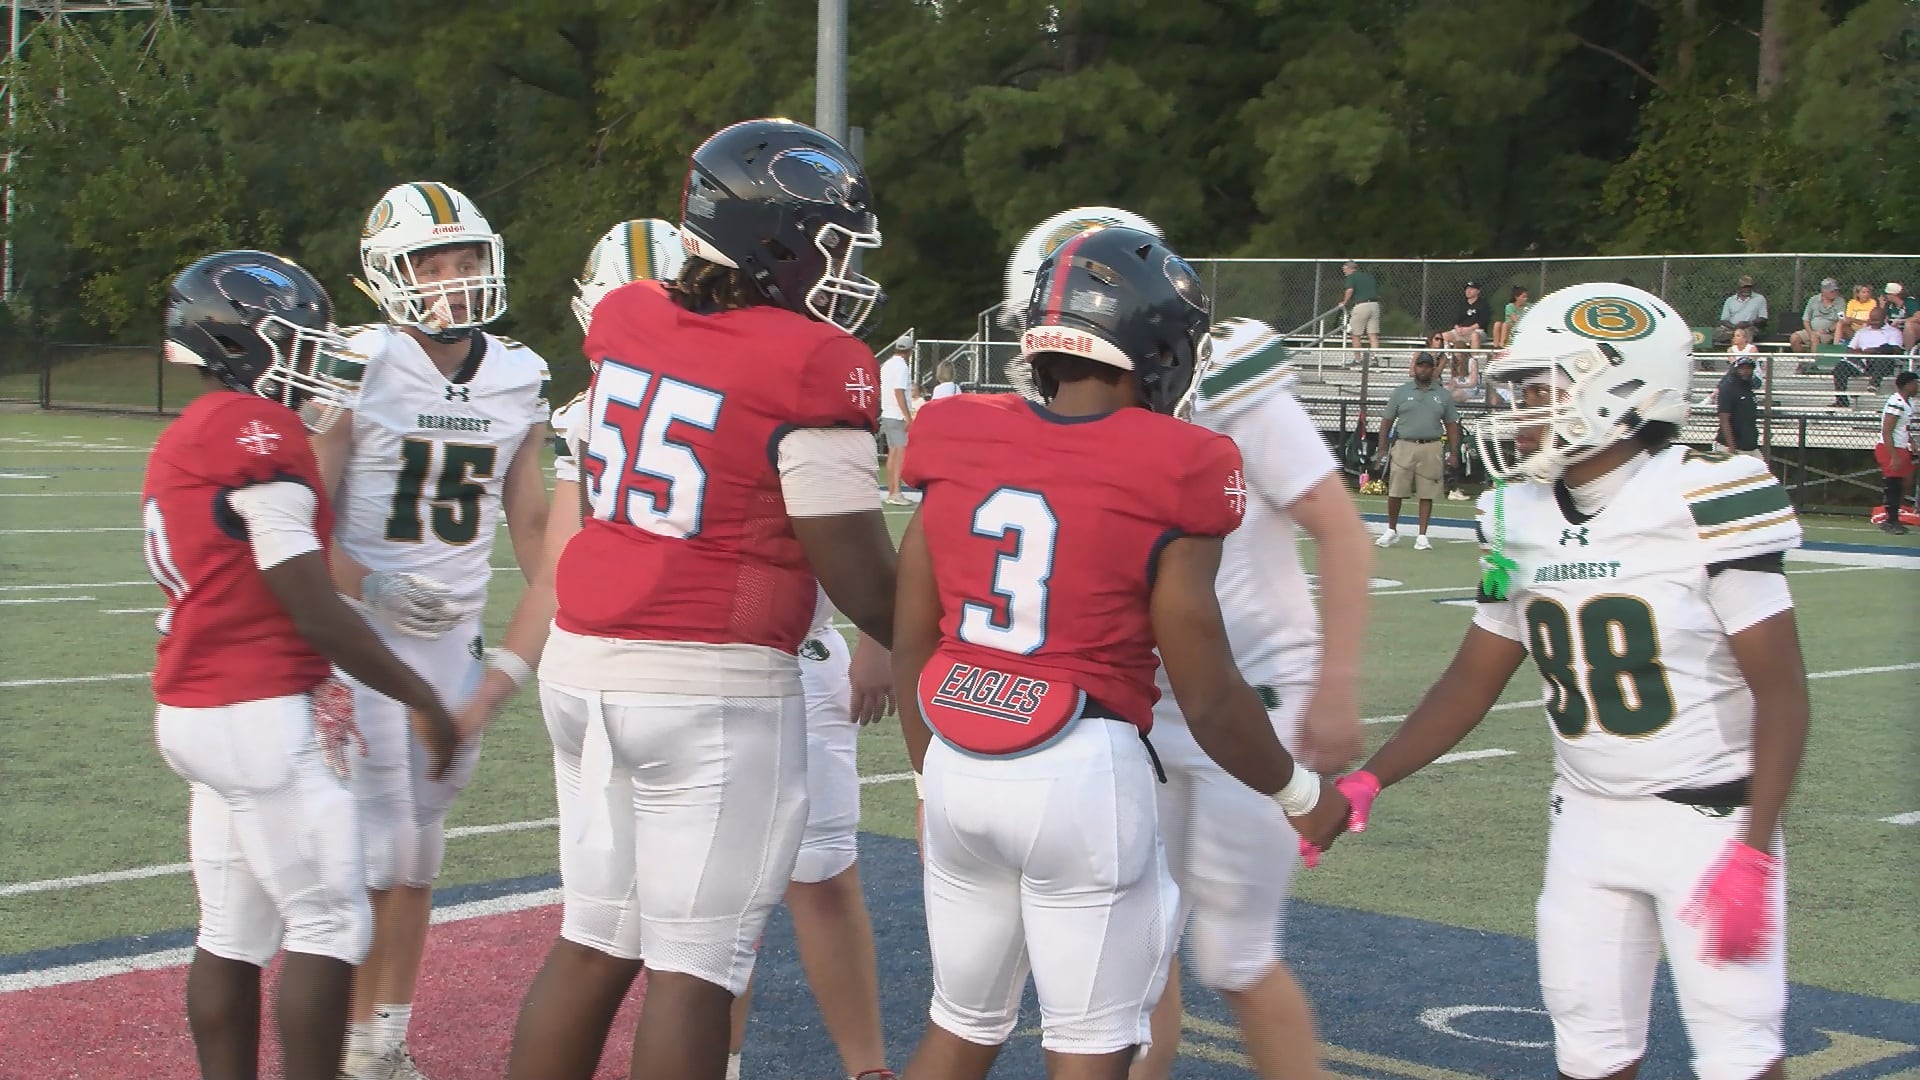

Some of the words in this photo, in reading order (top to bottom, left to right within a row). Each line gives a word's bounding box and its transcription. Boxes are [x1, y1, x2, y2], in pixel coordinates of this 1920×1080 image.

[1025, 331, 1094, 353] Riddell
[417, 413, 492, 433] BRIARCREST
[586, 357, 727, 540] 55
[383, 435, 499, 547] 15
[957, 486, 1059, 657] 3
[1534, 560, 1623, 584] BRIARCREST
[935, 662, 1050, 714] EAGLES
[1523, 593, 1680, 742] 88
